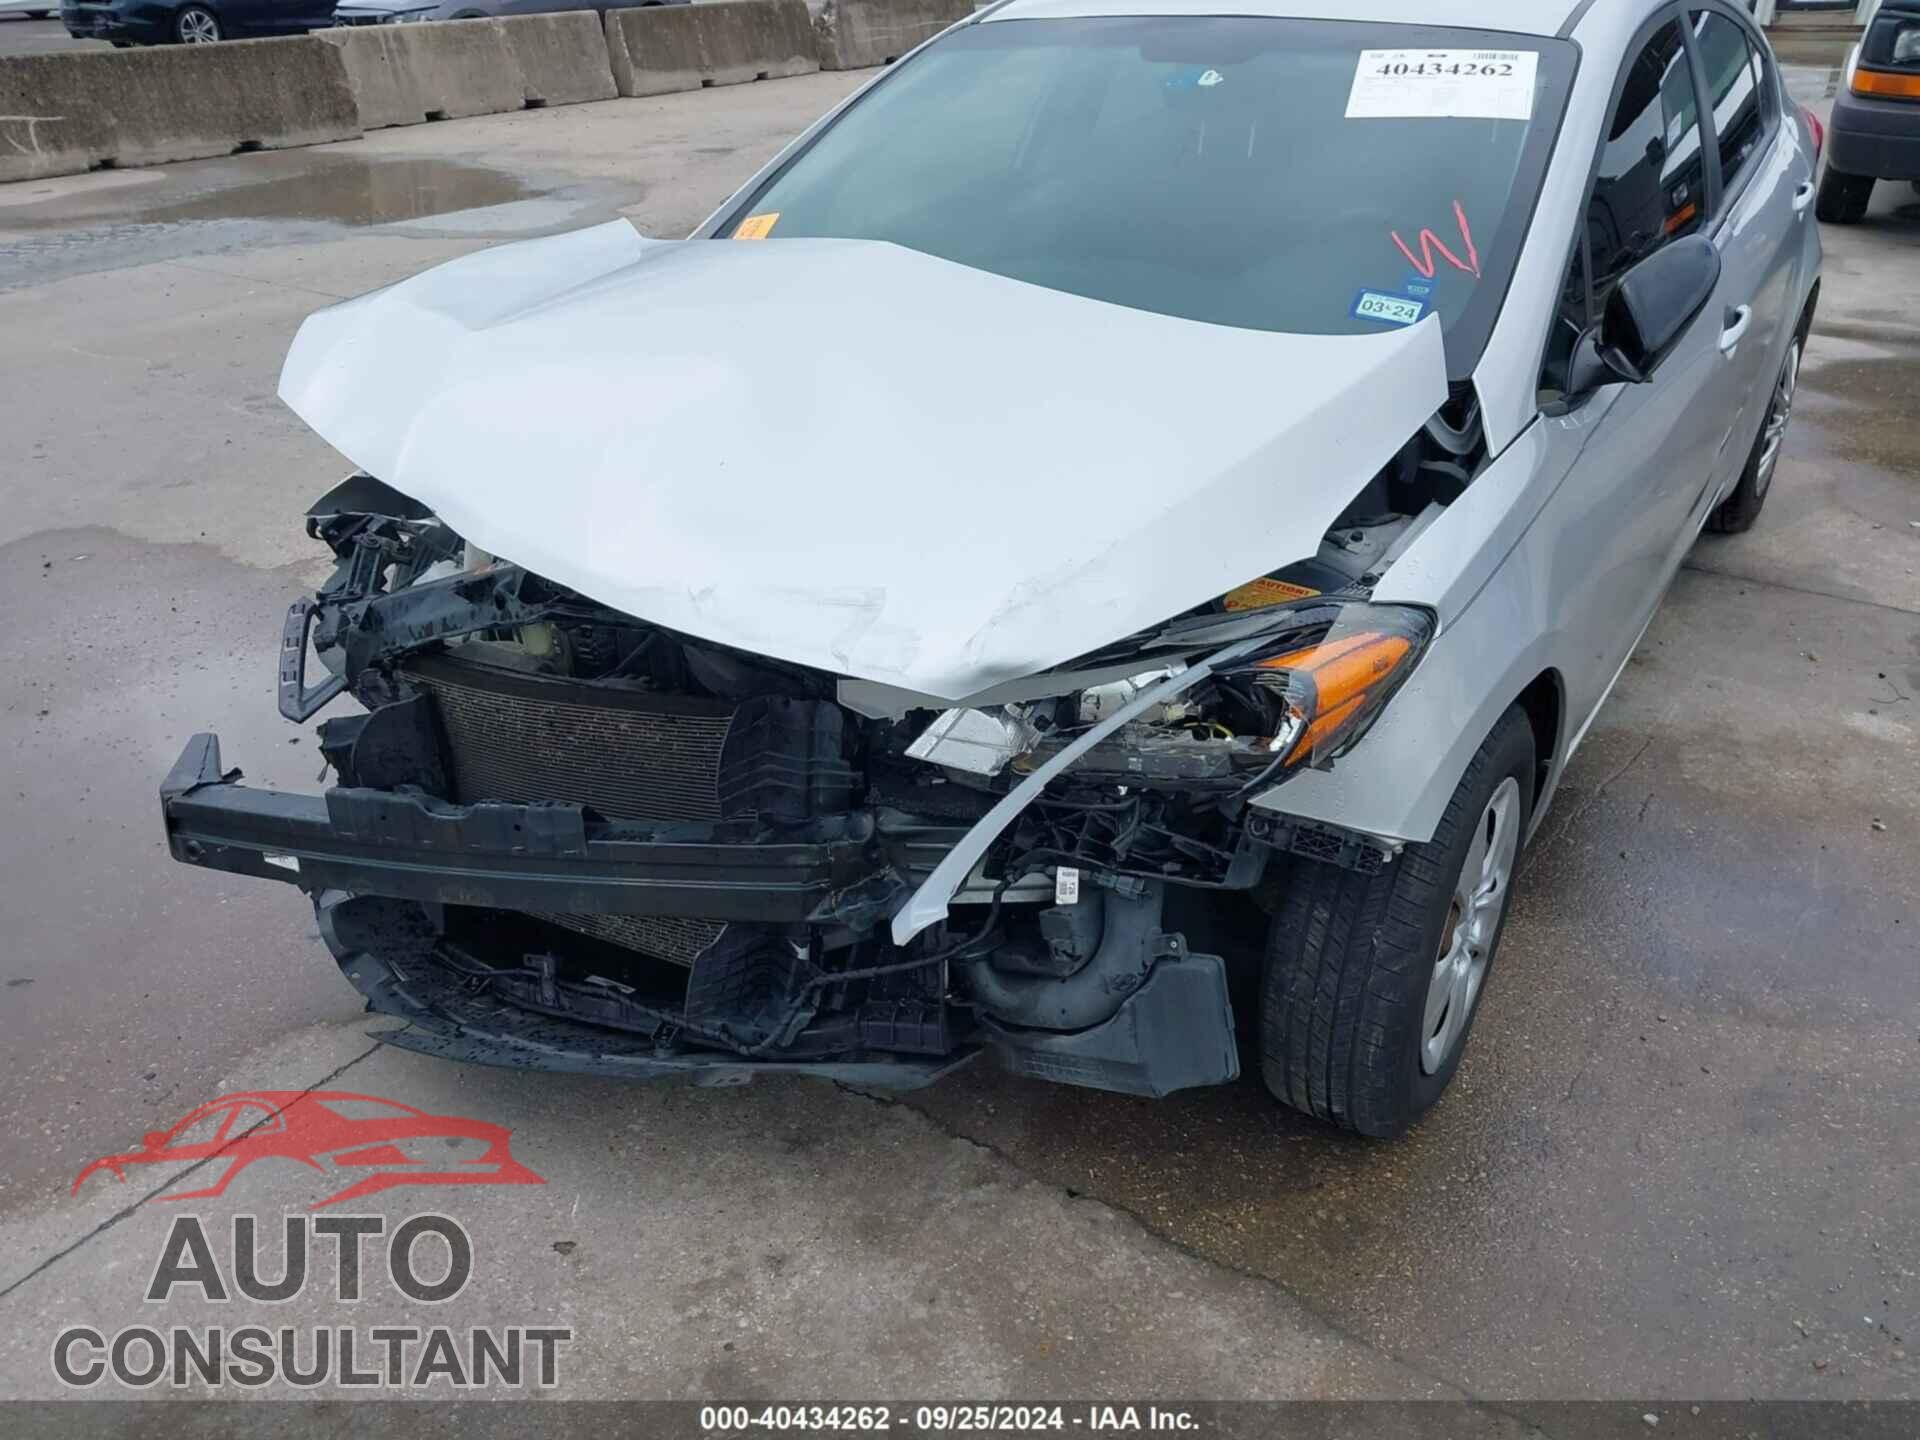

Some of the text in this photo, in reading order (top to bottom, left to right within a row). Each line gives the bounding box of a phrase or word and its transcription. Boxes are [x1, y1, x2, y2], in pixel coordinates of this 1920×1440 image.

[1376, 62, 1513, 77] 40434262
[1361, 299, 1416, 319] 03 24
